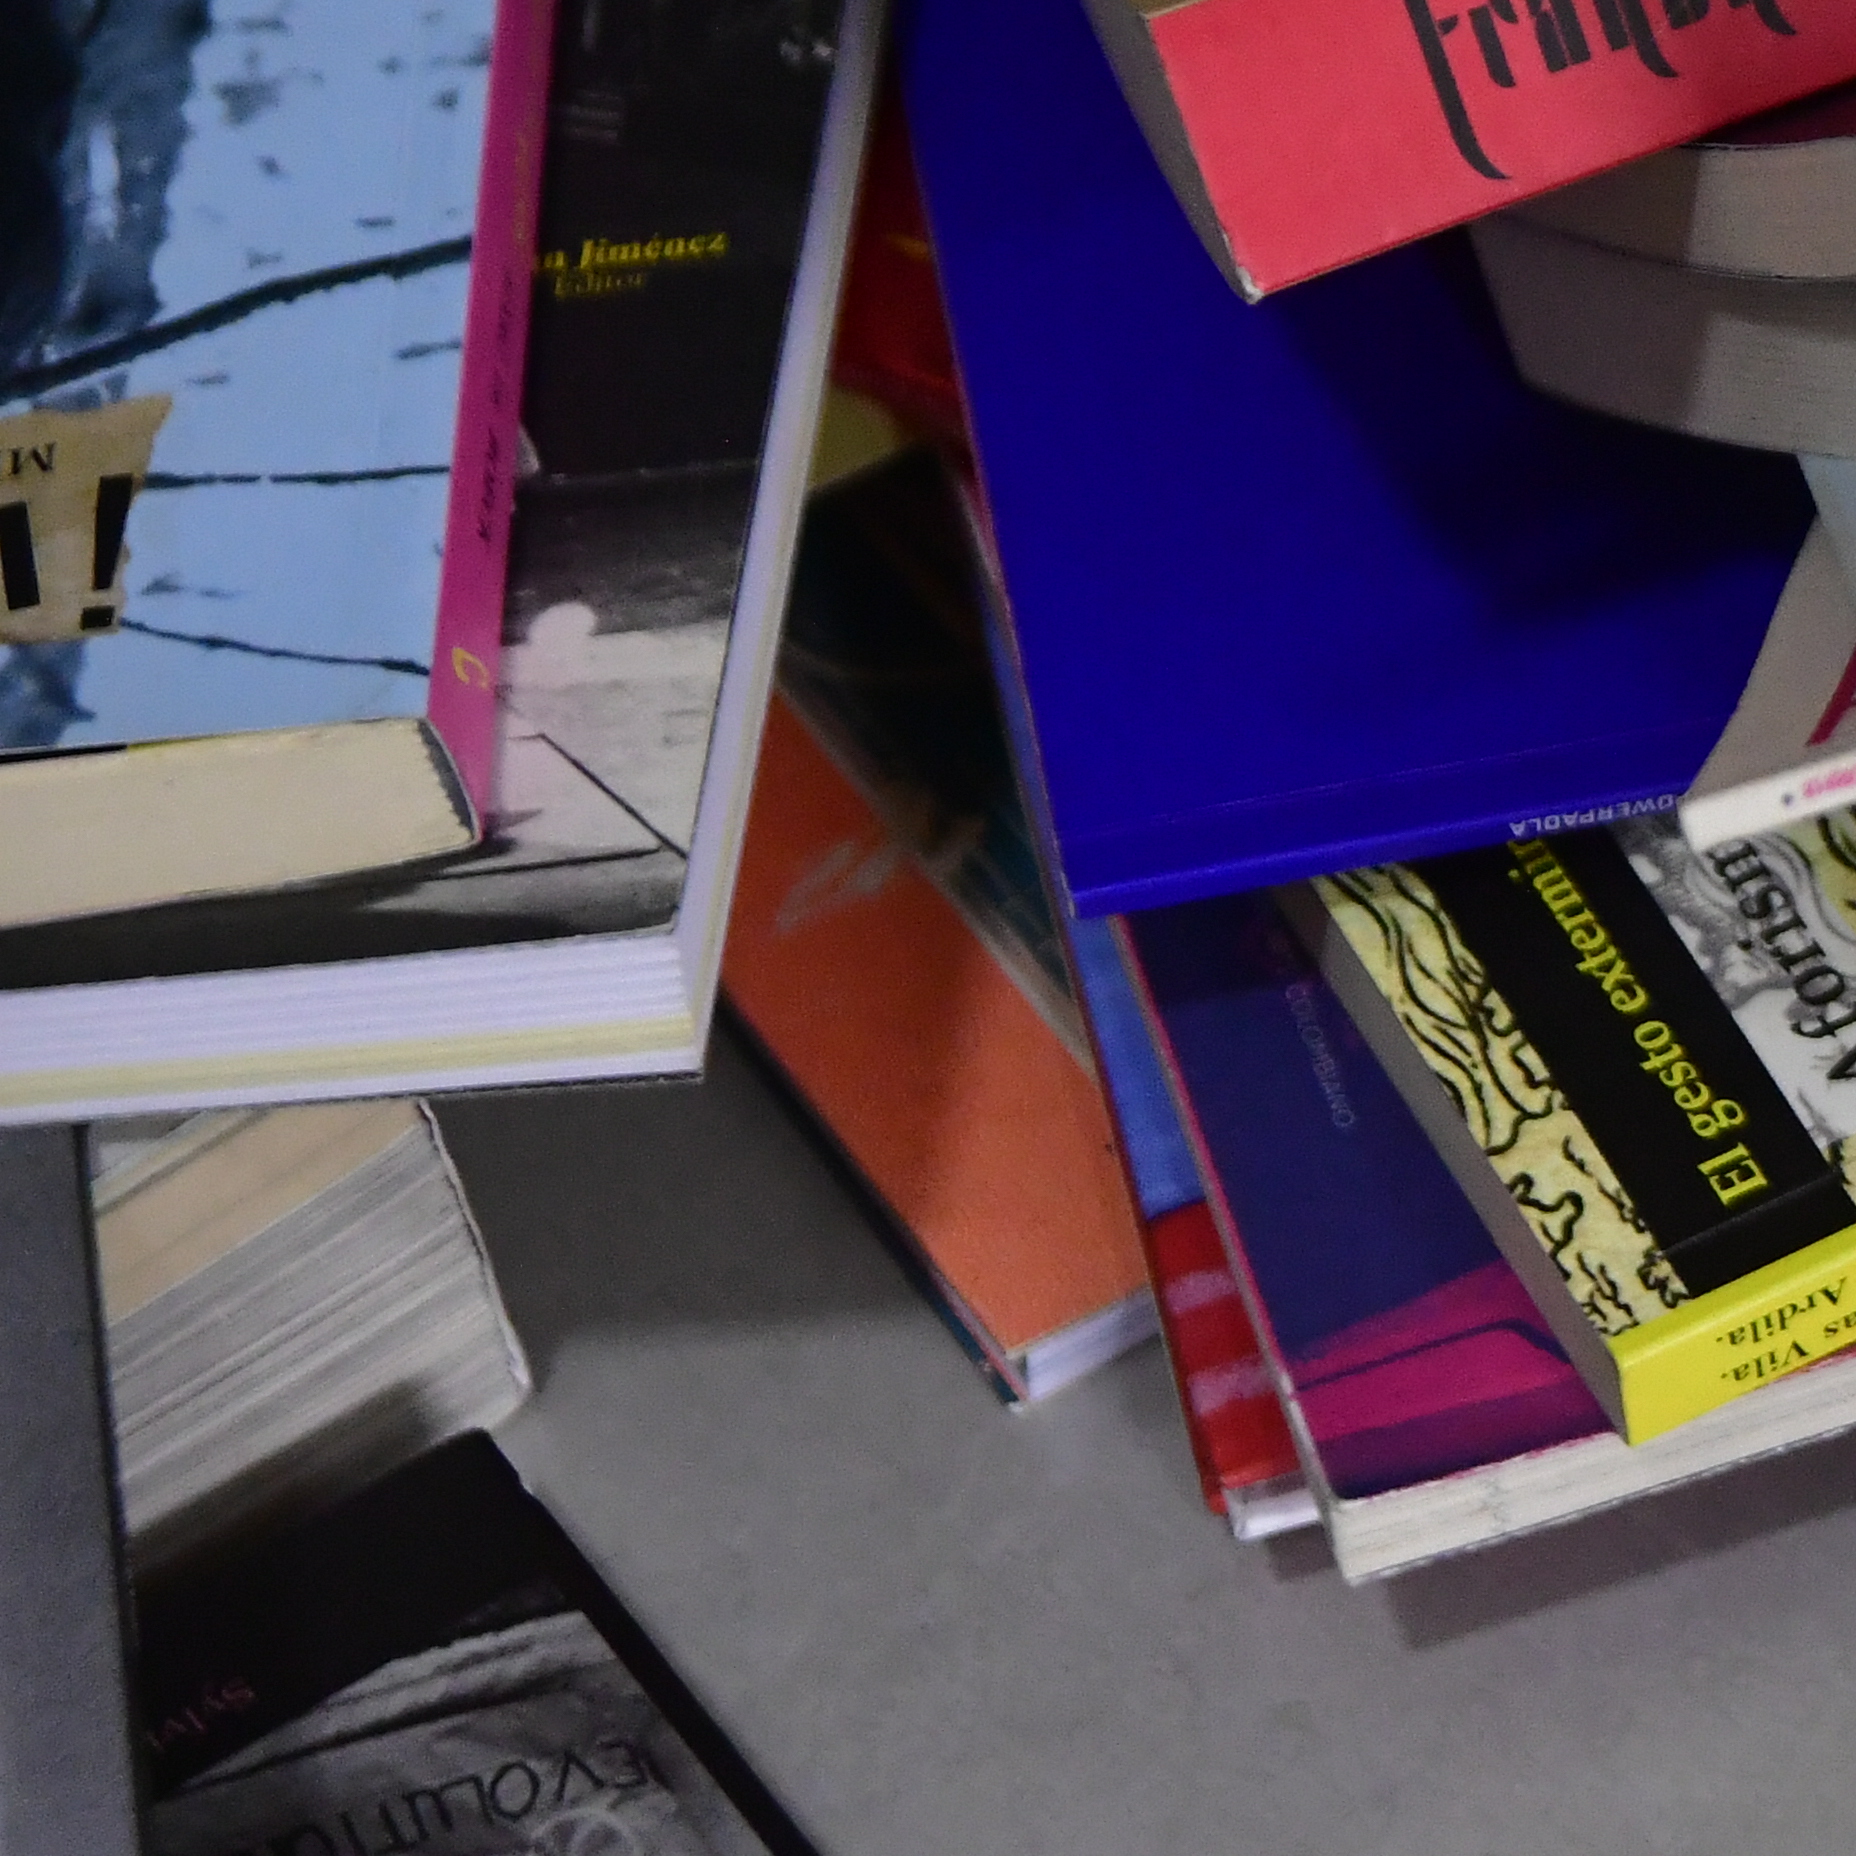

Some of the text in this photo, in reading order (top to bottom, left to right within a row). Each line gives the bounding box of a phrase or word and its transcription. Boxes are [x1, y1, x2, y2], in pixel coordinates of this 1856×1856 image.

[1510, 795, 1676, 836] OWERPAOLA
[1634, 1021, 1746, 1138] gesto
[1698, 1144, 1767, 1204] El
[1712, 1282, 1842, 1347] Ardila.
[1717, 1336, 1811, 1388] Vila.
